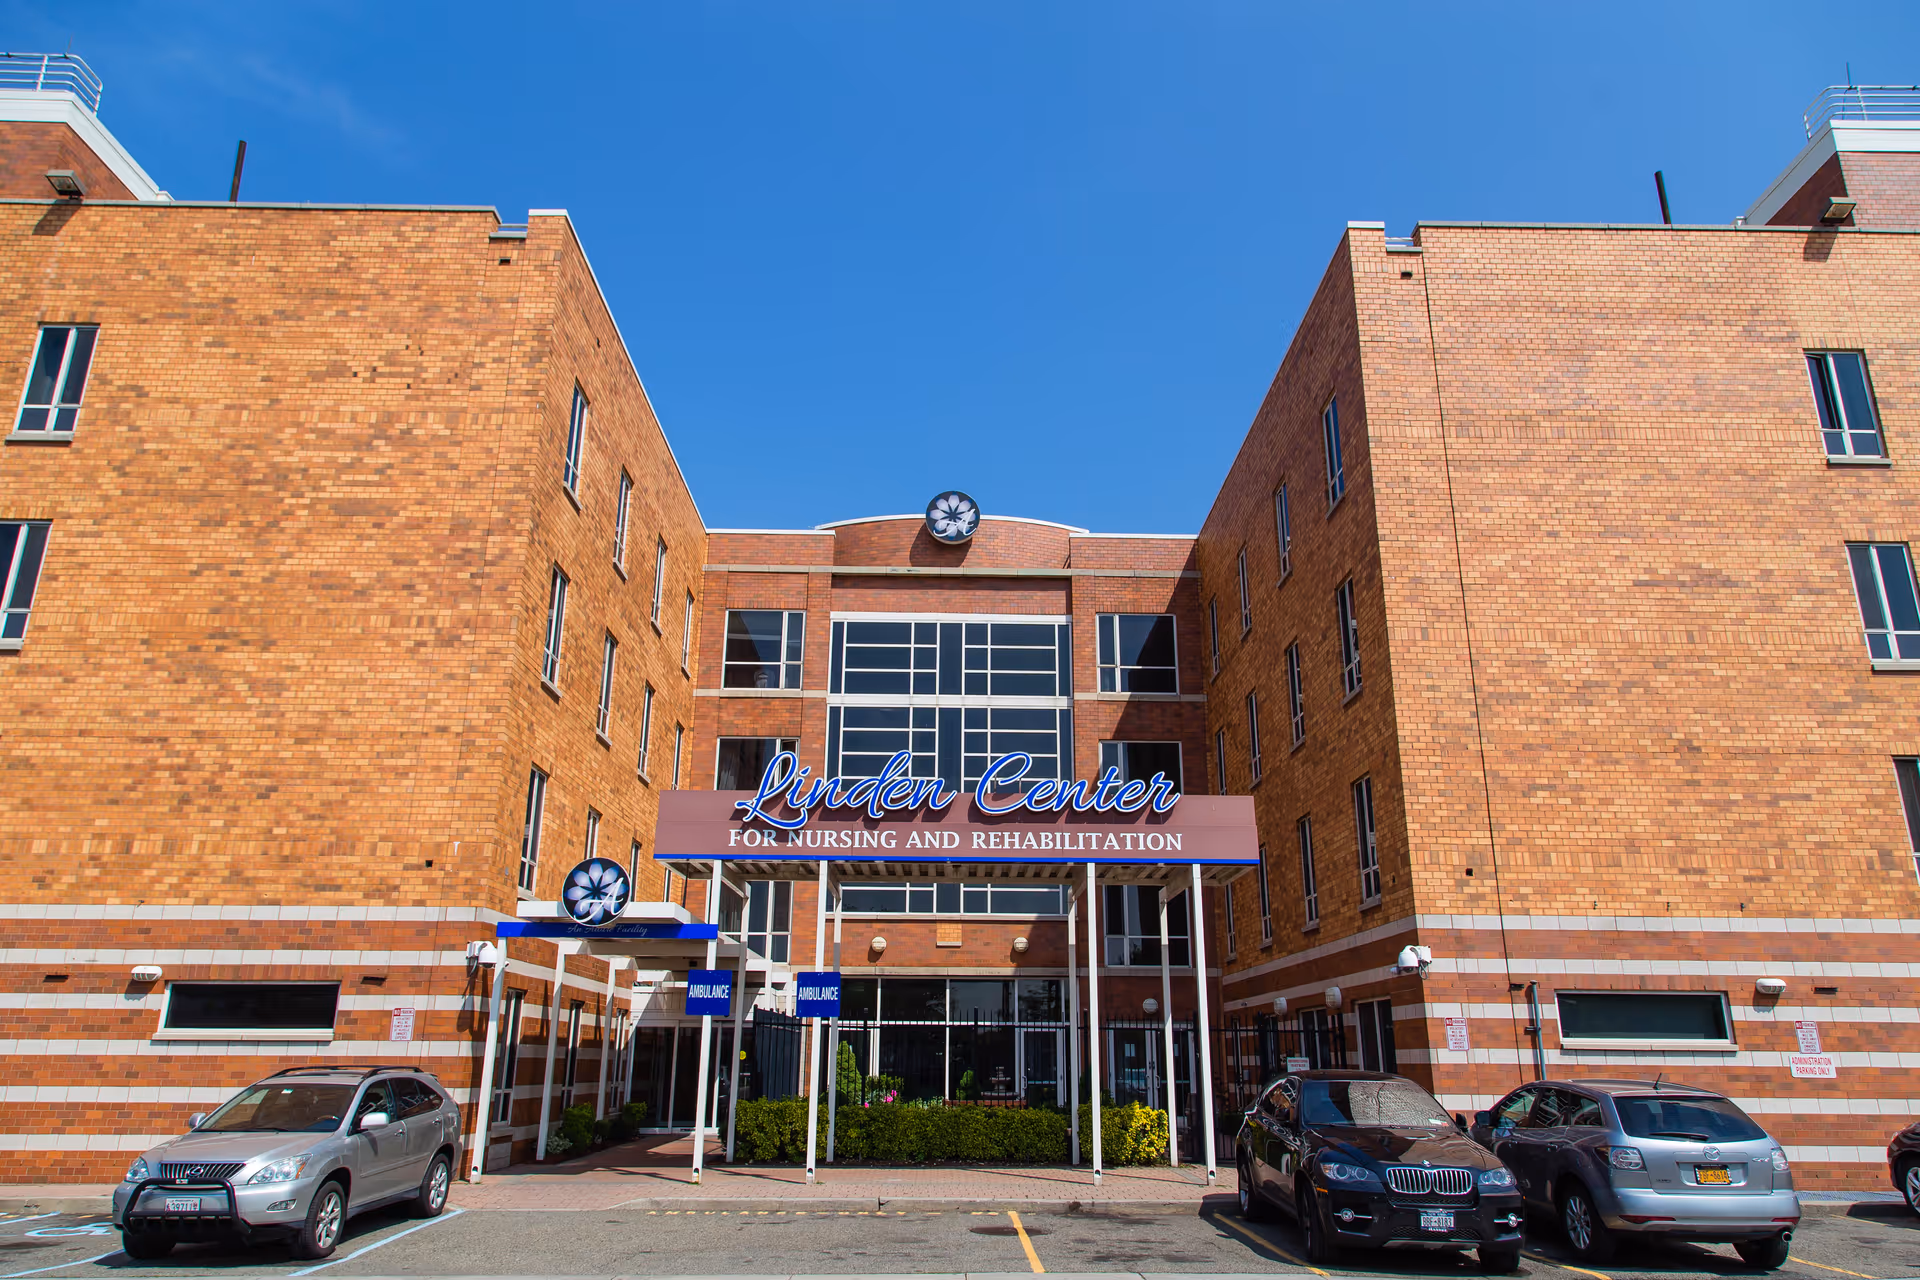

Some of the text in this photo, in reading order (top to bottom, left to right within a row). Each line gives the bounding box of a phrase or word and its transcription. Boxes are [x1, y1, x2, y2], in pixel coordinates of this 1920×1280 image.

[734, 749, 1181, 829] Linden Center
[728, 829, 1183, 851] FOR NURSING AND REHABILITATION
[616, 924, 648, 937] Facility
[688, 984, 730, 999] AMBULANCE
[797, 986, 839, 1001] AMBULANCE
[1791, 1056, 1832, 1066] ADMINISTRATION
[1795, 1066, 1830, 1076] PARKING ONLY
